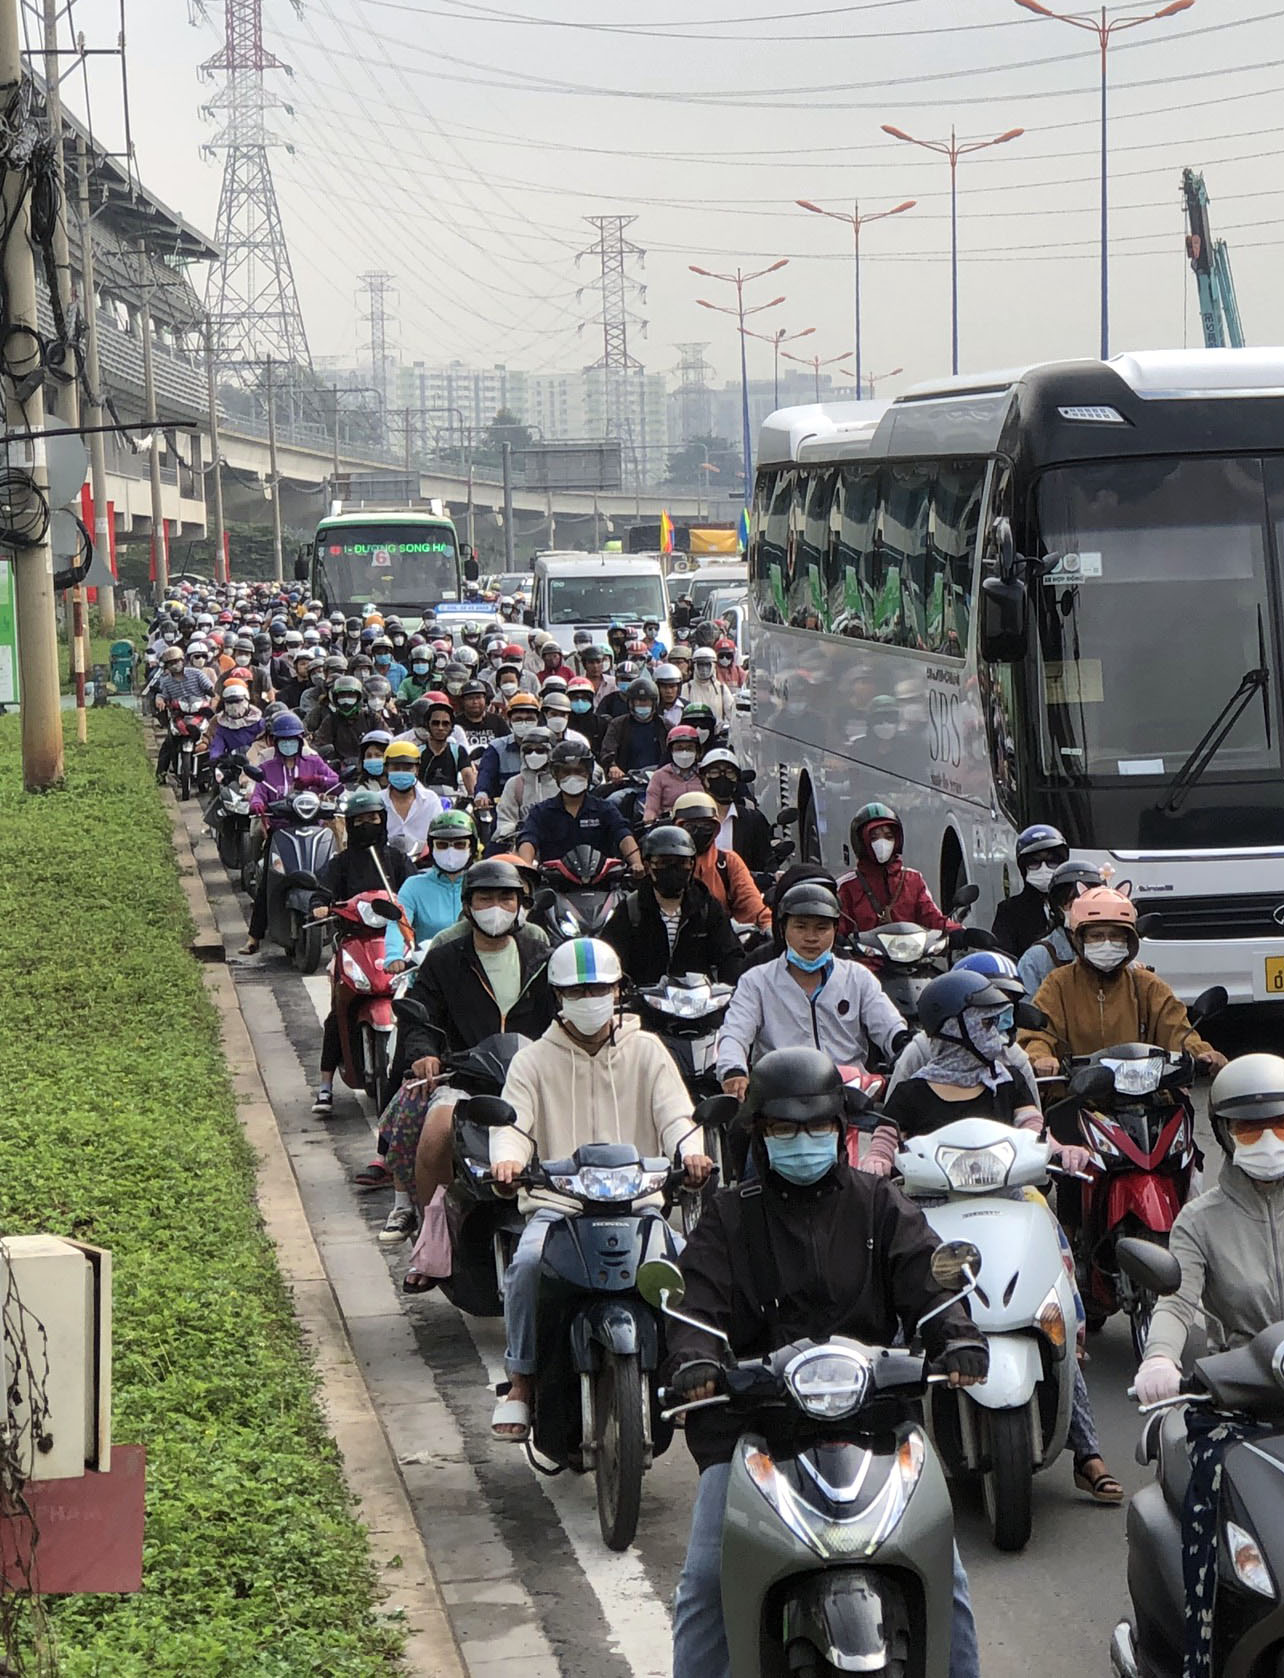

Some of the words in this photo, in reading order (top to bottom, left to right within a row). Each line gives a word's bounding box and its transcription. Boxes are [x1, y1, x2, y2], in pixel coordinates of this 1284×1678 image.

[399, 543, 431, 553] SONG
[375, 551, 387, 564] 6
[929, 688, 961, 768] SBS
